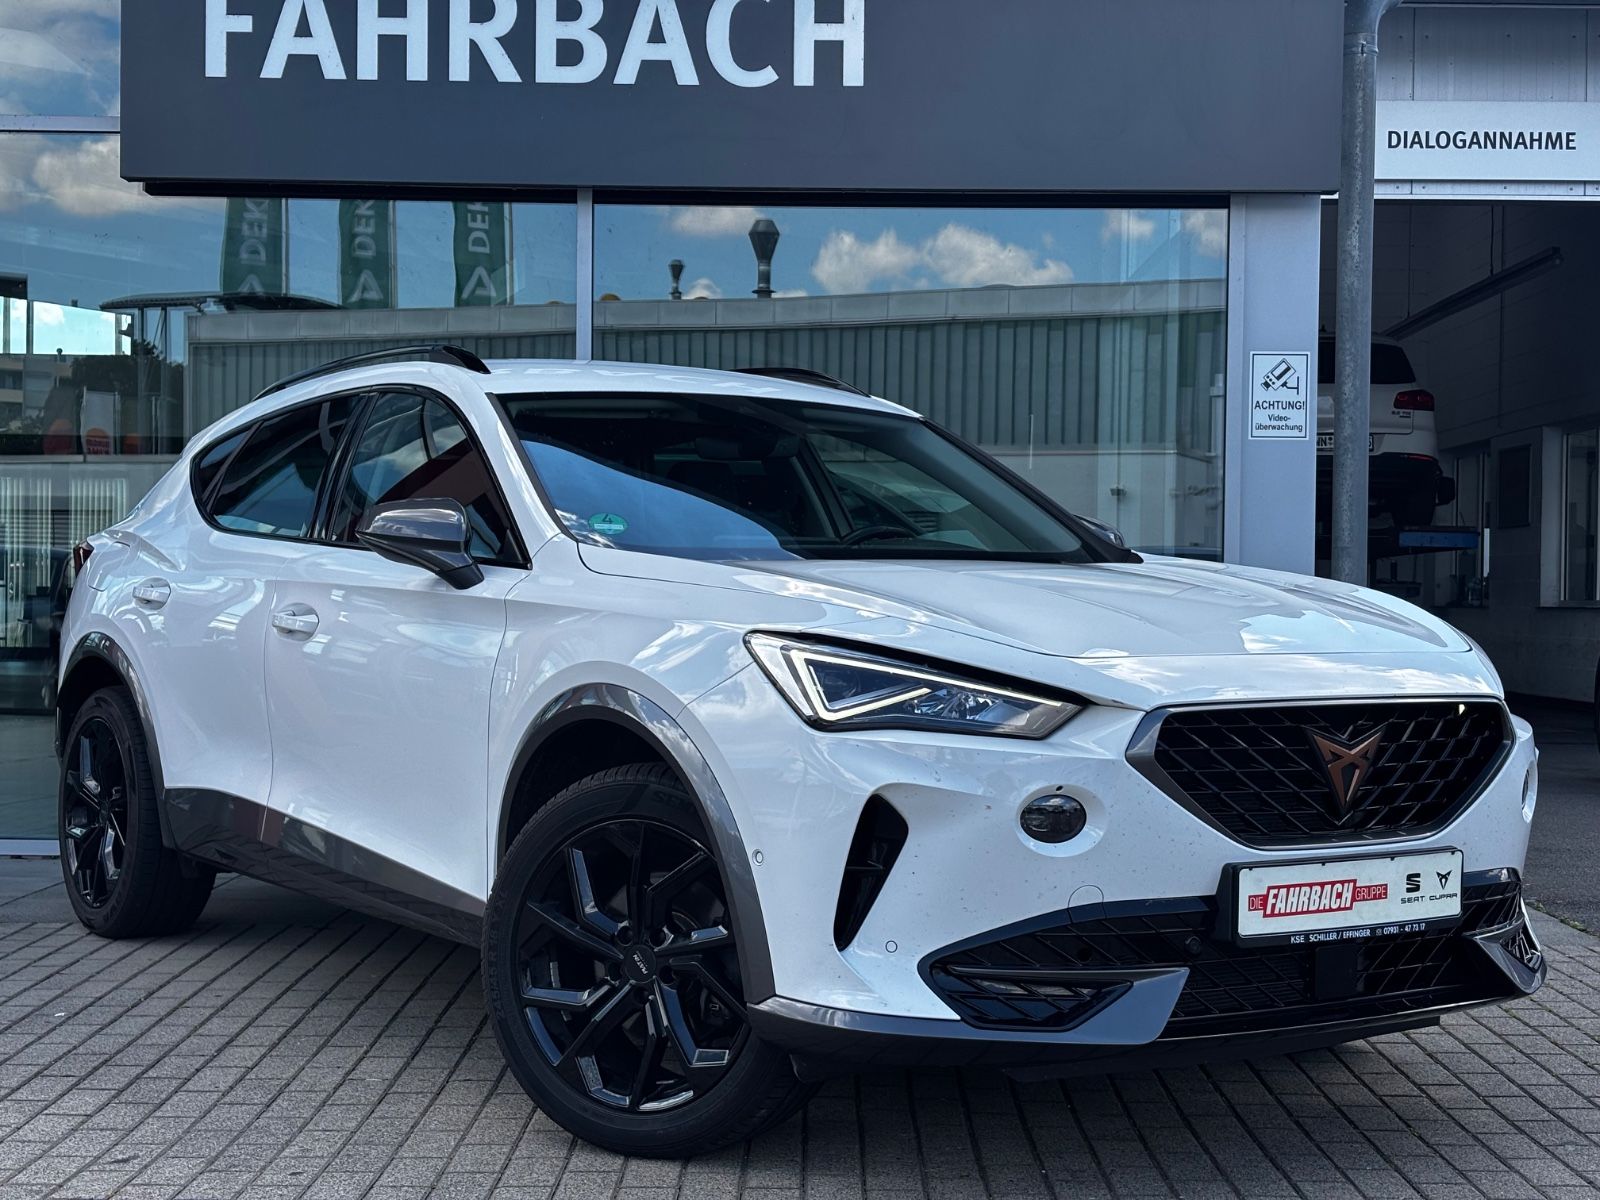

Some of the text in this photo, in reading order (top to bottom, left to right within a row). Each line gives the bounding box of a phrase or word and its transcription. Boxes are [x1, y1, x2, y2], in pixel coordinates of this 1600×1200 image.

[203, 0, 865, 87] FAHRBACH
[1387, 130, 1577, 150] DIALOGANNAHME
[1254, 400, 1305, 410] ACHTUNG!
[1268, 414, 1291, 422] Video-
[1255, 423, 1303, 432] überwachung
[602, 514, 615, 524] 4
[1249, 882, 1387, 915] DIE FAHRBACH GRUPPE
[1400, 892, 1458, 905] SEAT CUPRA
[1290, 935, 1305, 944] KSE
[1309, 932, 1337, 942] SCHILLER
[1343, 929, 1370, 939] EFFINGER
[1383, 925, 1399, 935] 07931
